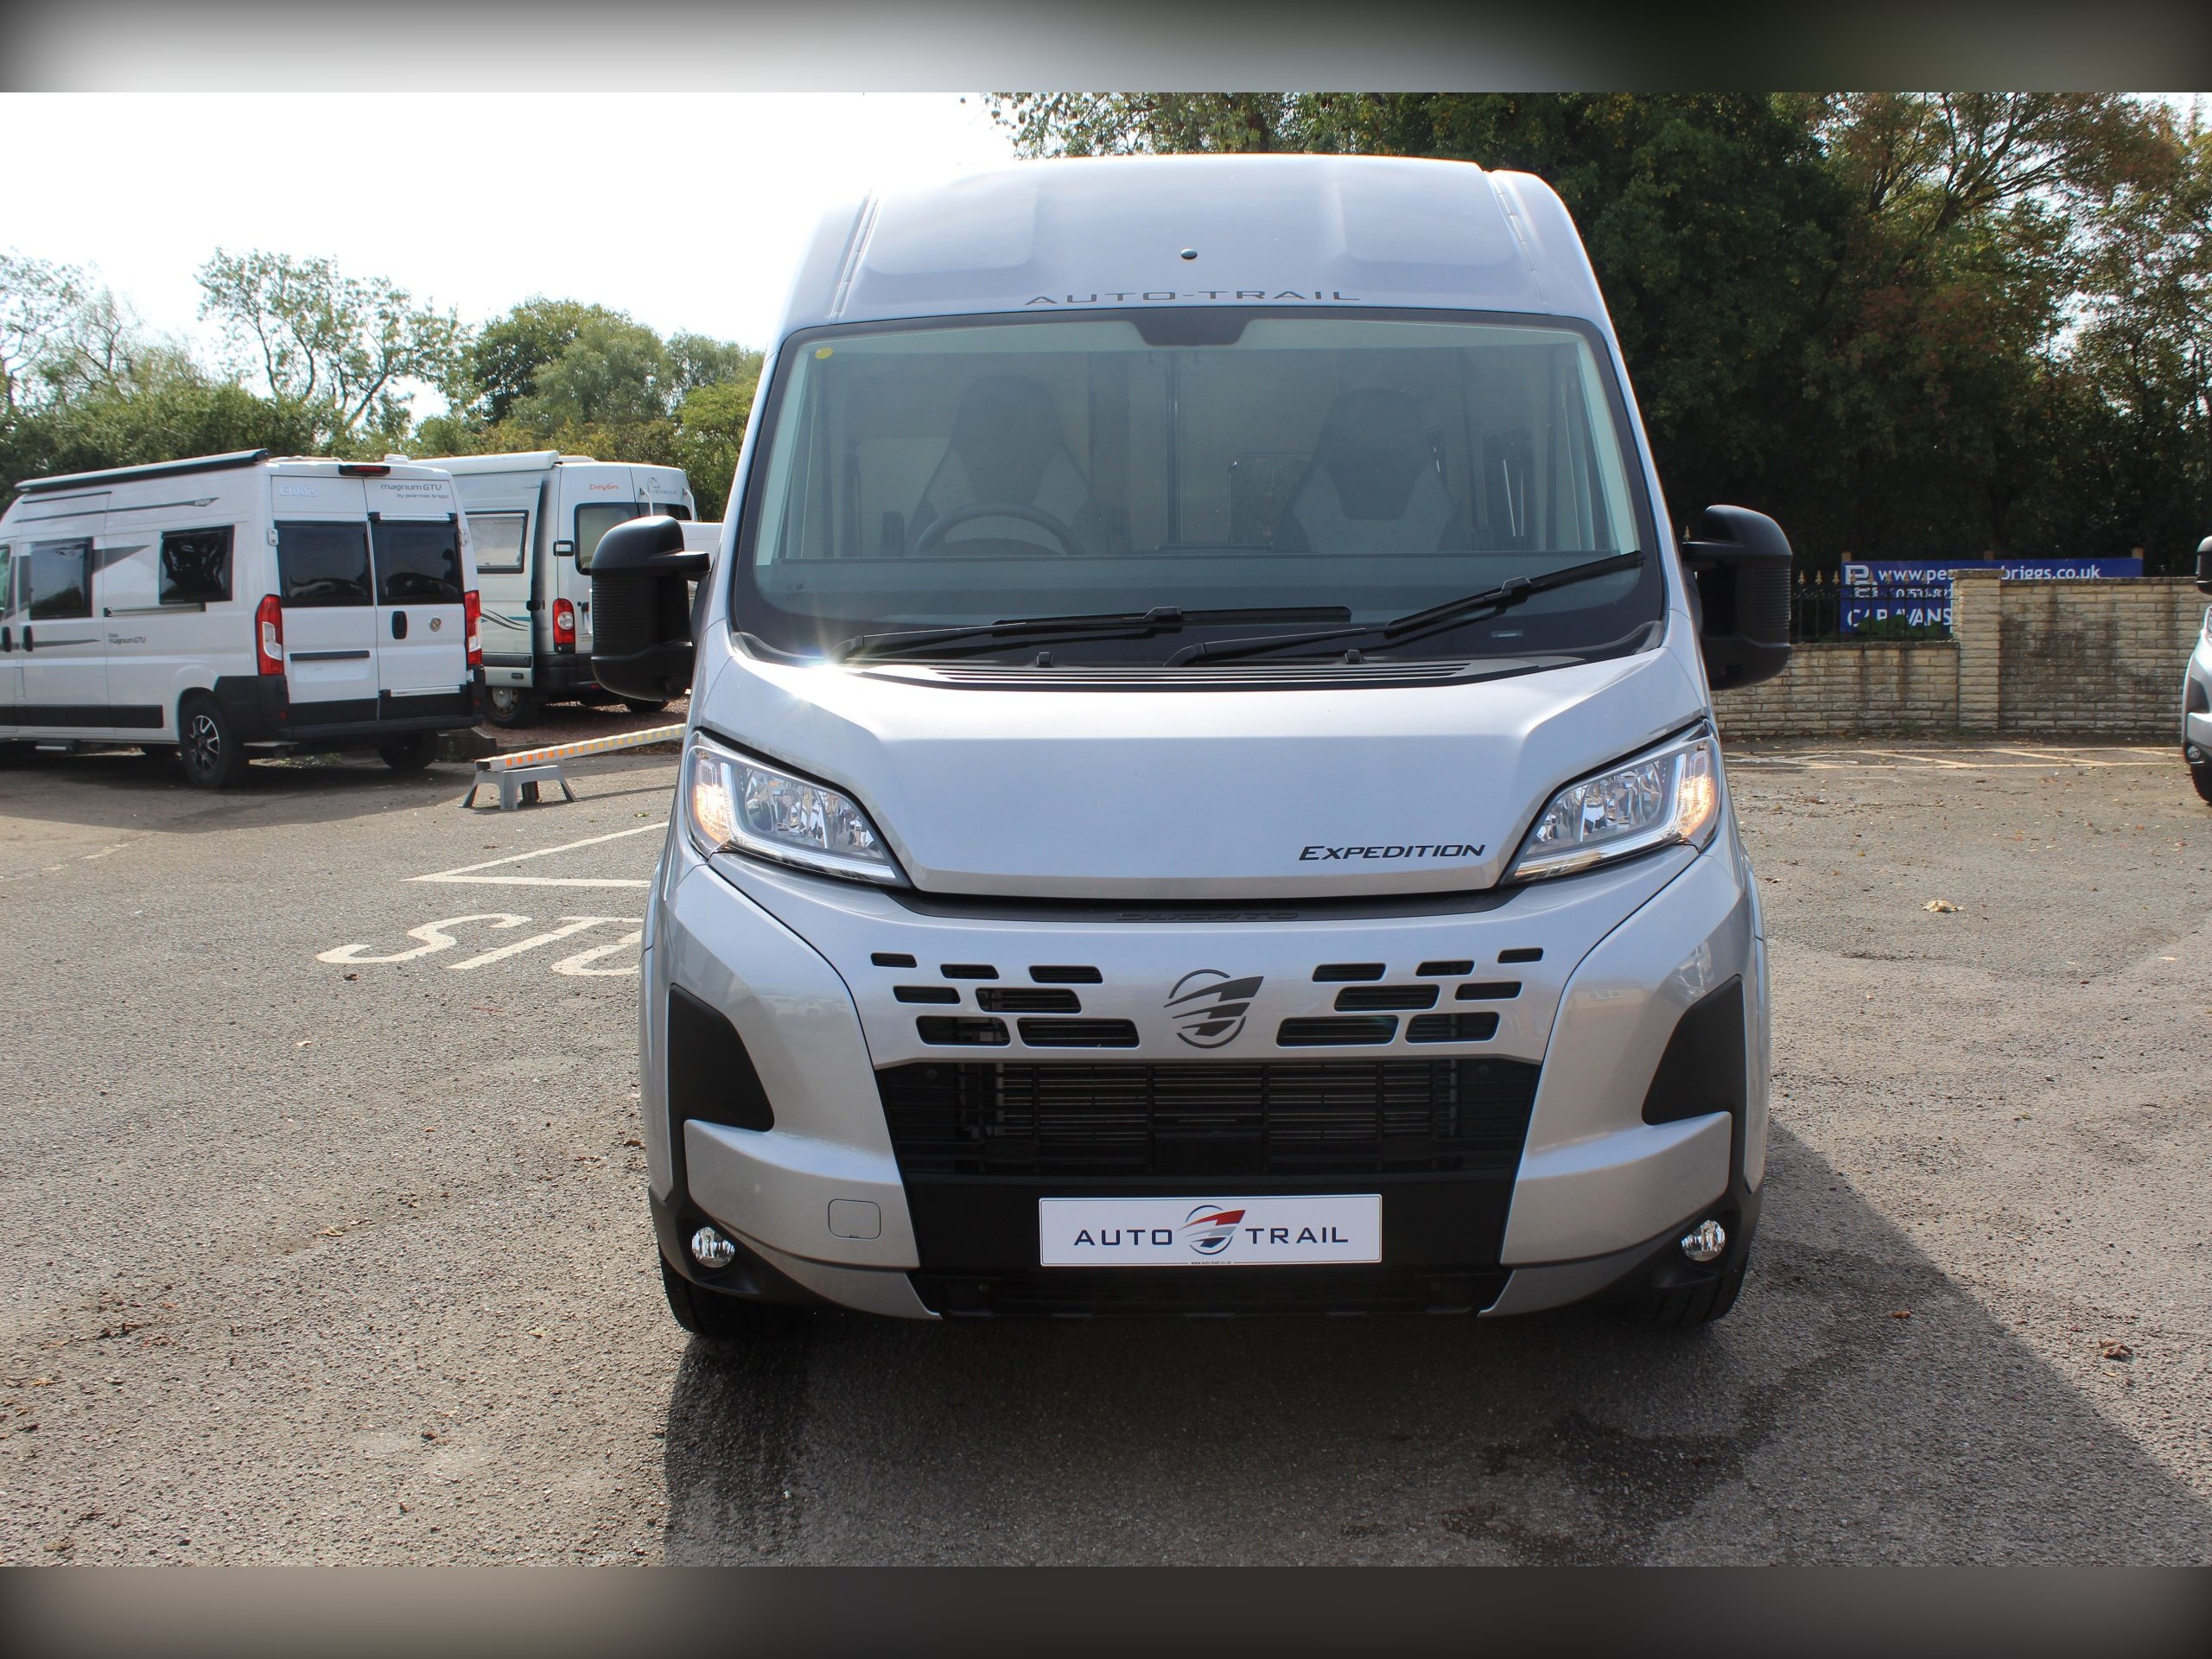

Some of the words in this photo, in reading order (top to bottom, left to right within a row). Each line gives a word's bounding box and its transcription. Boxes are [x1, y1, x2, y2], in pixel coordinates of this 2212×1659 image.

[1024, 290, 1361, 306] AUTO-TRAIL
[380, 484, 423, 493] magnum
[1299, 844, 1486, 861] EXPEDITION
[1073, 1228, 1173, 1247] AUTO
[1244, 1225, 1349, 1245] TRAIL
